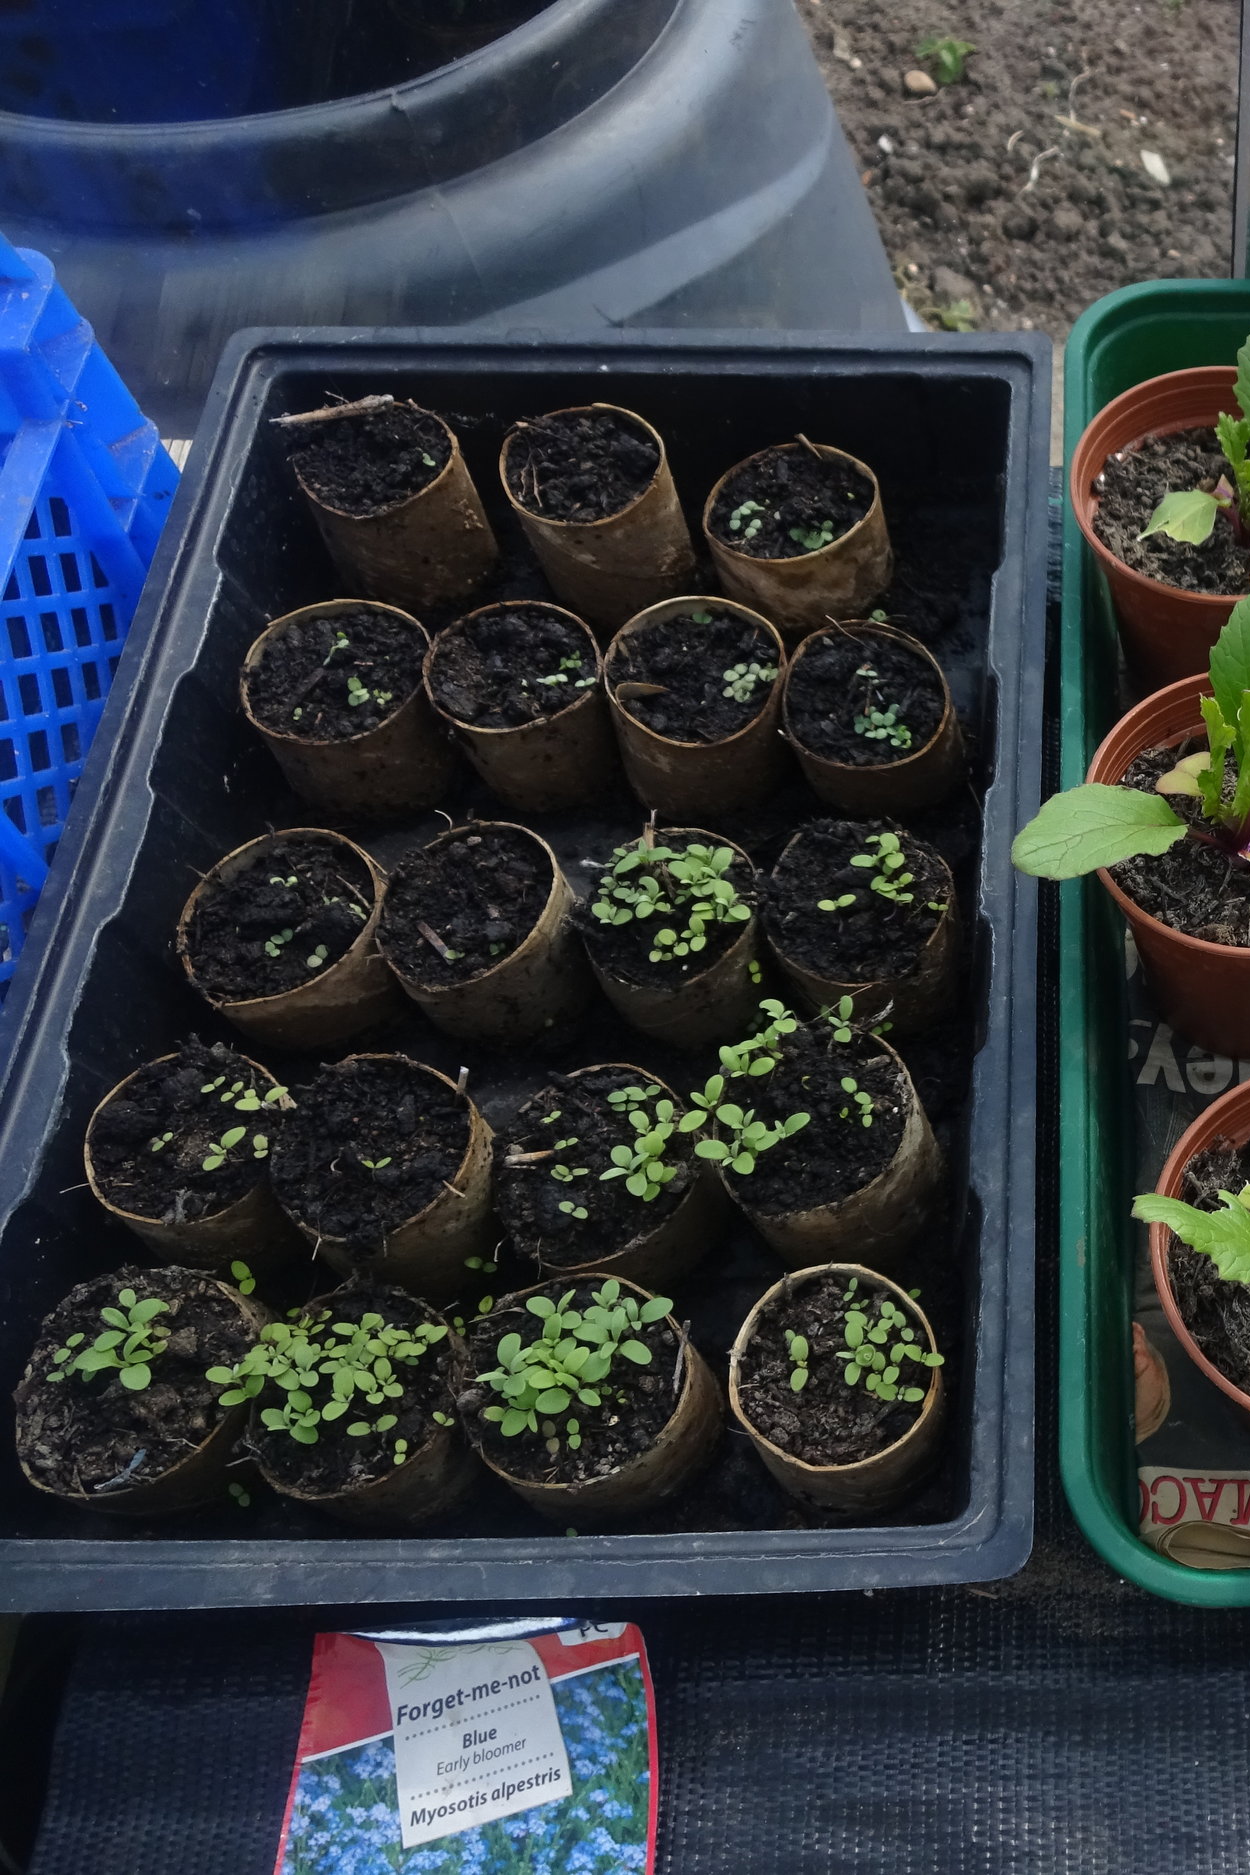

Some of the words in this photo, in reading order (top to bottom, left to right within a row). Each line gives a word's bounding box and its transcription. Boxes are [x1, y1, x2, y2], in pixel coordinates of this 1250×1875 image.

[396, 1664, 541, 1726] Forget-me-not
[436, 1754, 470, 1776] Early
[472, 1737, 527, 1765] bloomer
[462, 1727, 498, 1749] Blue
[410, 1791, 488, 1827] Myosotis
[491, 1767, 562, 1802] alpestris
